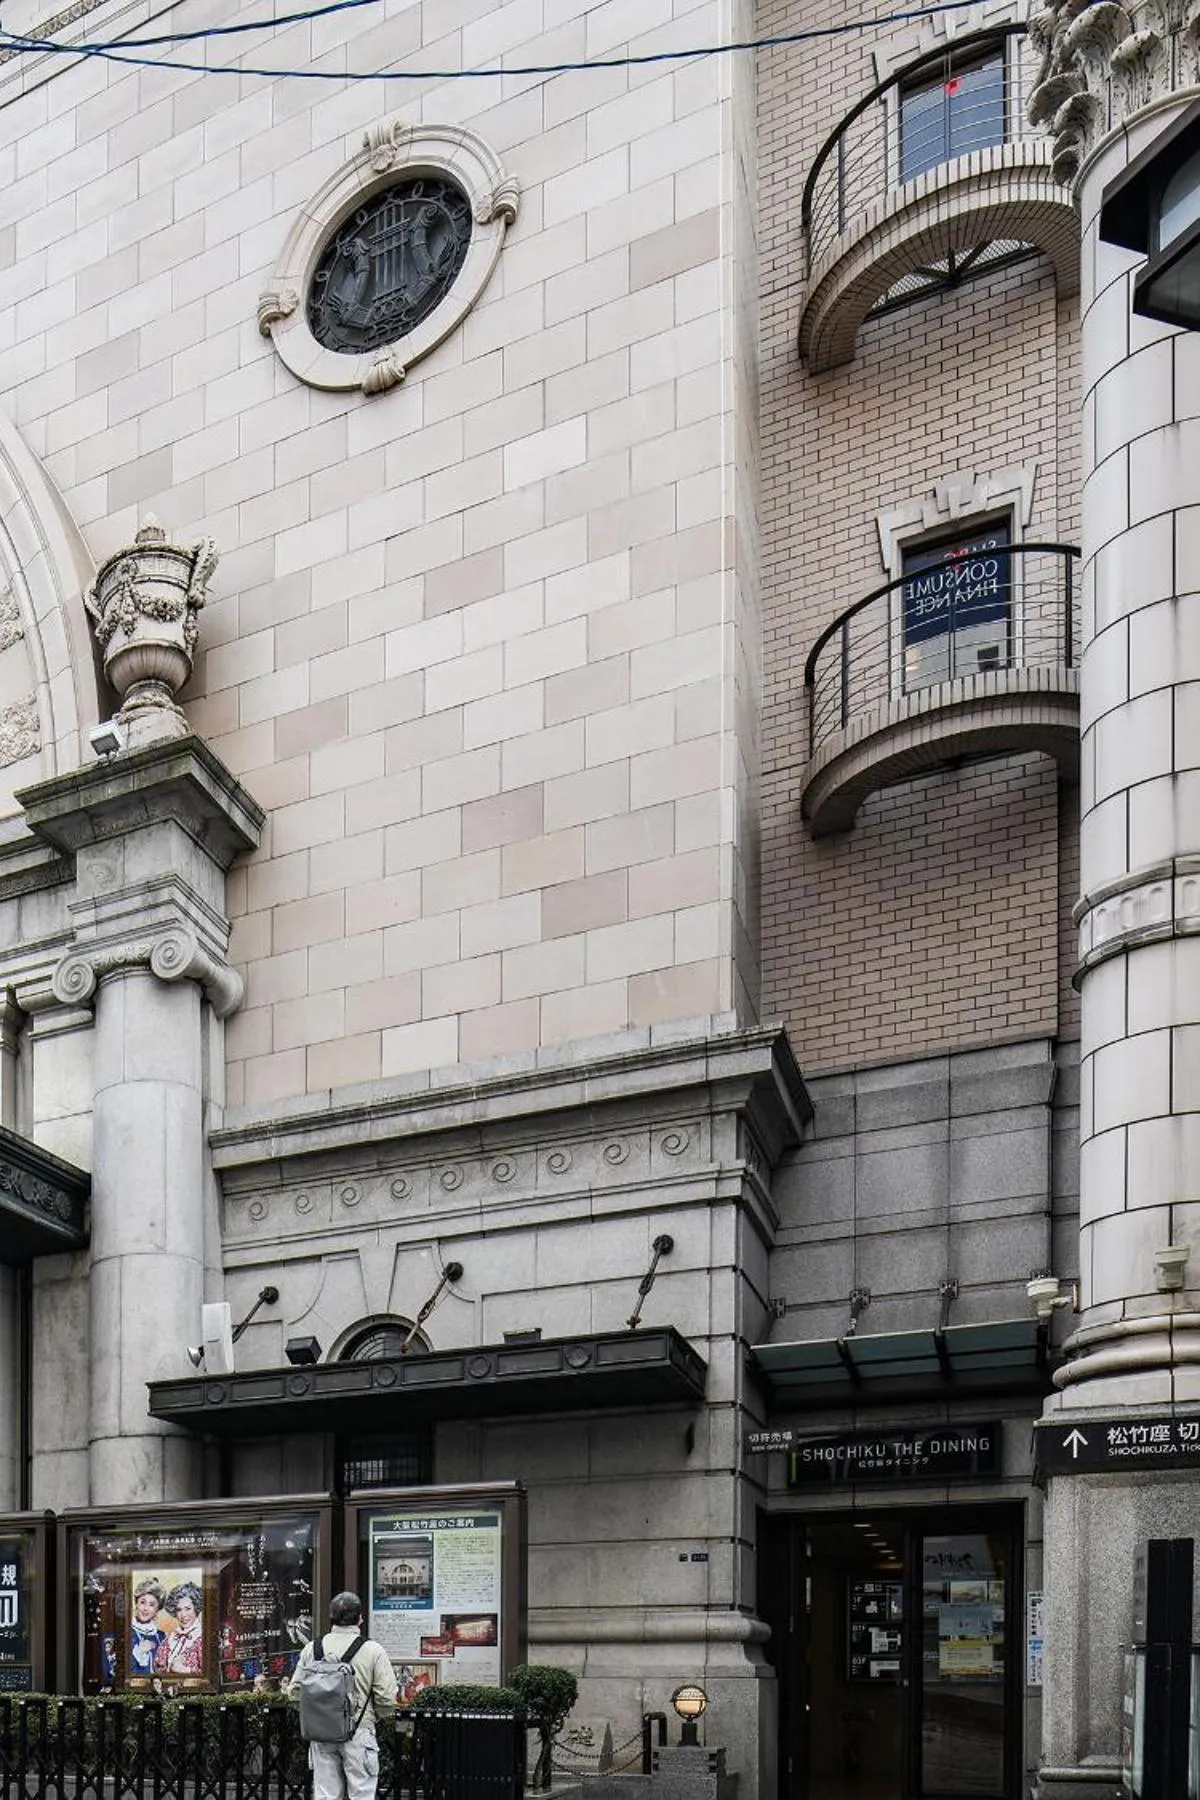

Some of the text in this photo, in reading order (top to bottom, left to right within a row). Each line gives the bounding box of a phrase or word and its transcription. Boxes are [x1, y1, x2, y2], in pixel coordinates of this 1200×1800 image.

[1107, 1424, 1171, 1445] 松竹座
[802, 1438, 990, 1462] SHOCHIKU THE DINING
[1108, 1443, 1178, 1457] SHOCHIKUZA
